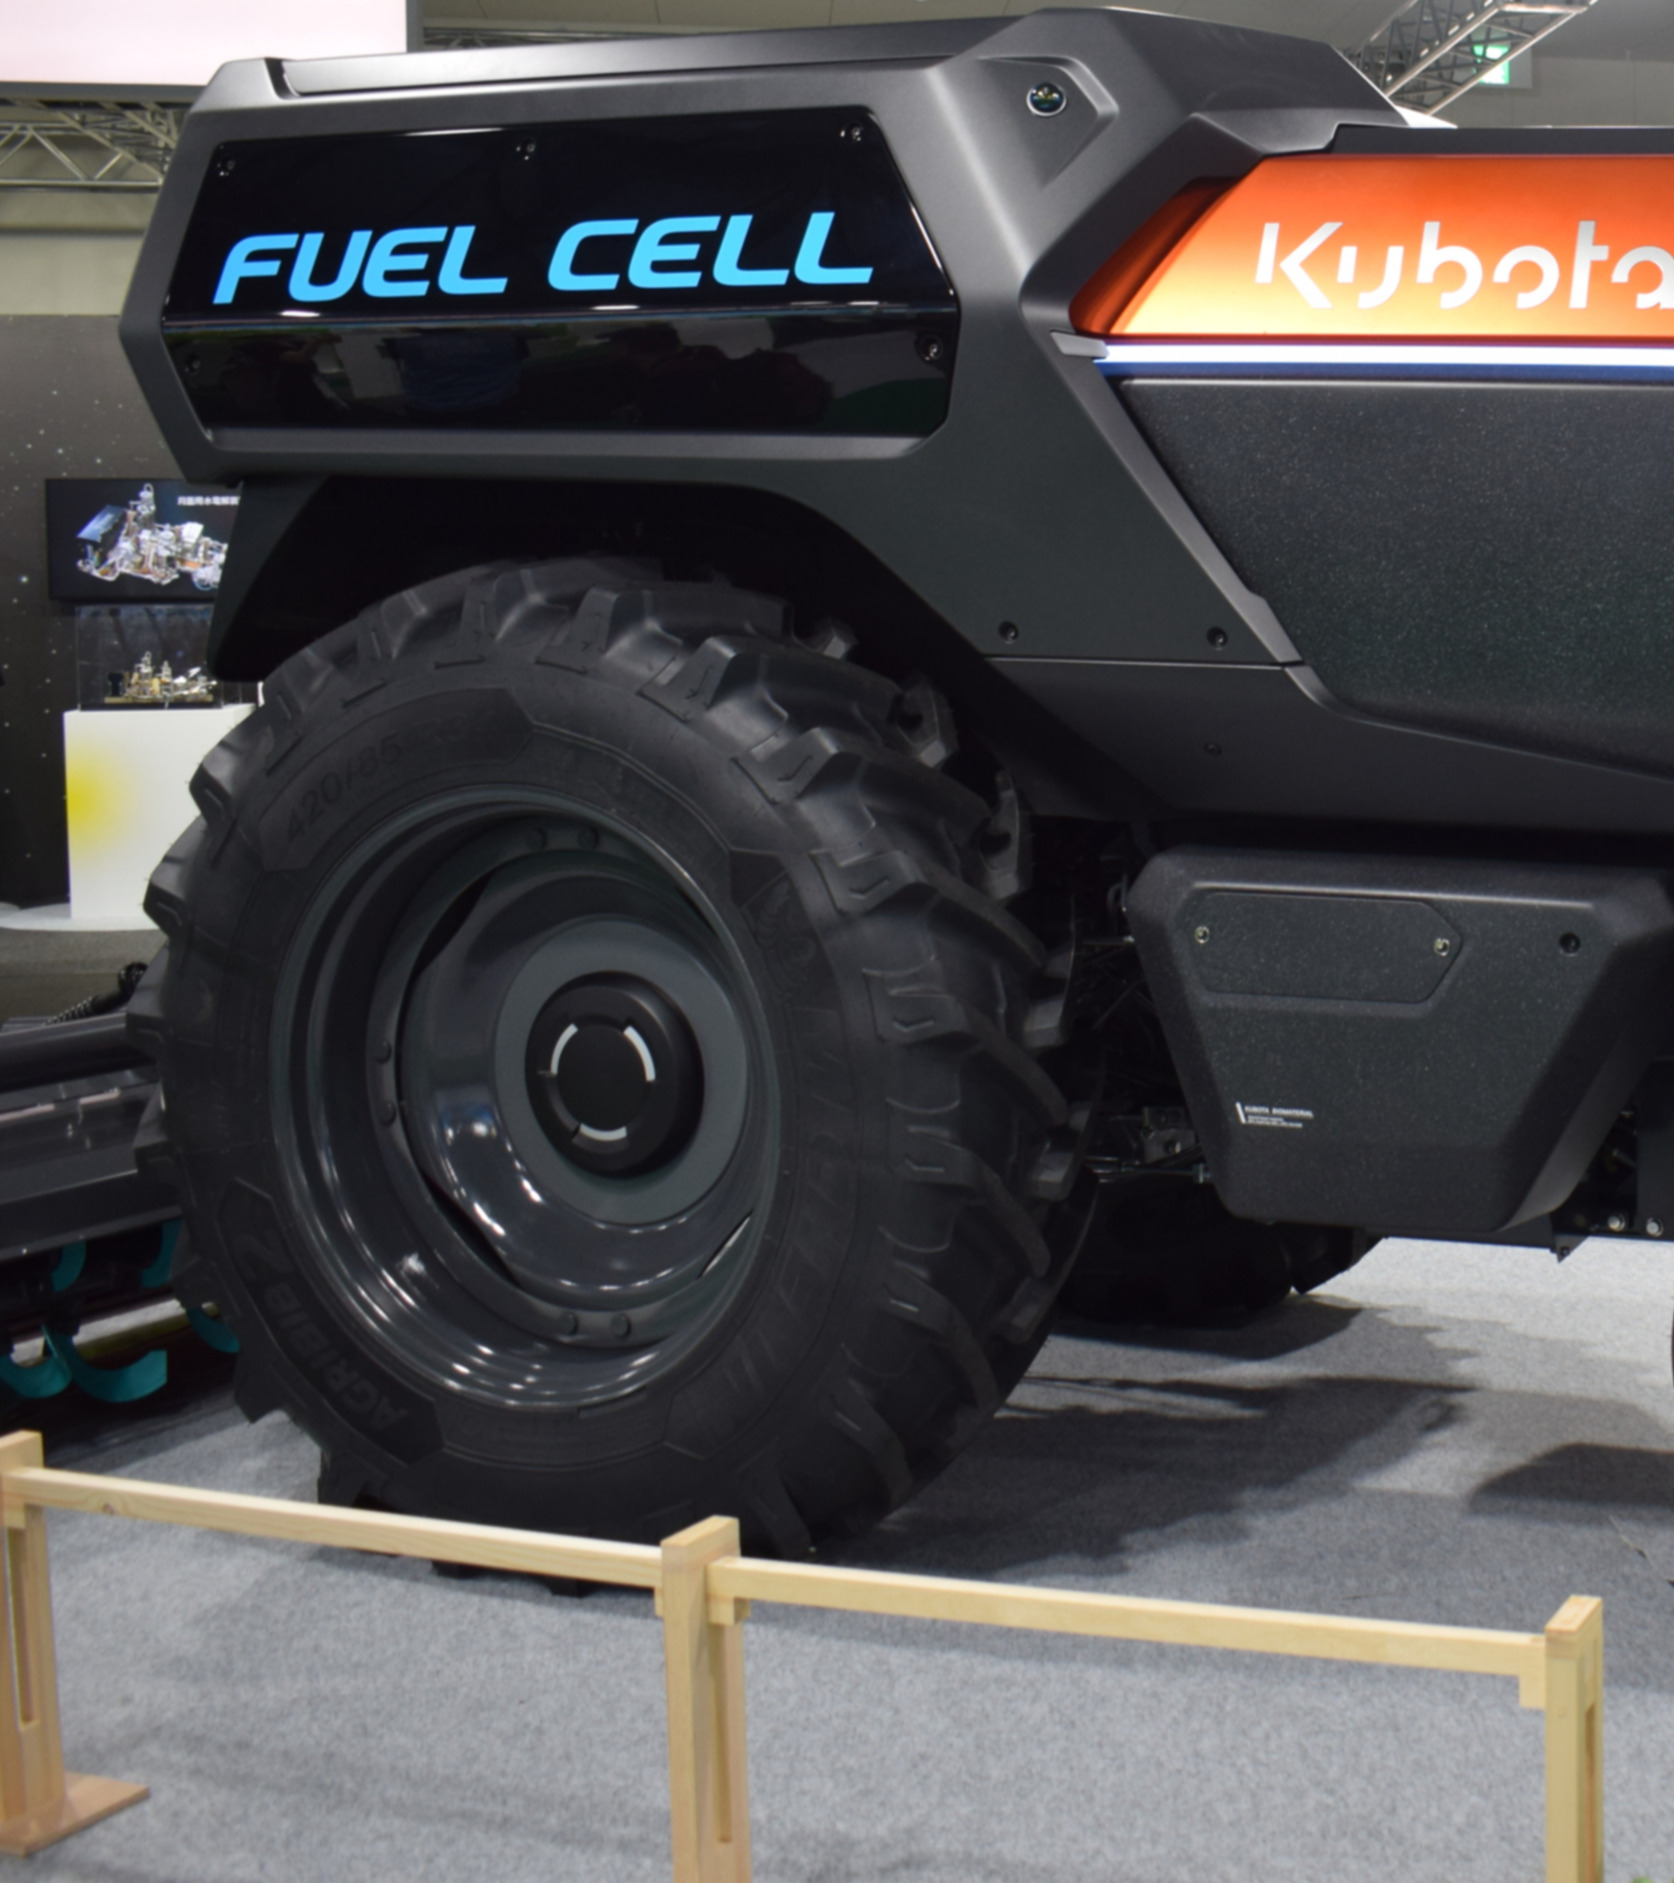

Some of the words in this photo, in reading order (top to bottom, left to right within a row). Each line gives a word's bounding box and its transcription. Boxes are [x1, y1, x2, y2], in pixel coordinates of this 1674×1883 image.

[213, 225, 508, 305] FUEL
[548, 211, 873, 291] CELL
[263, 1281, 411, 1432] AGRIBIB
